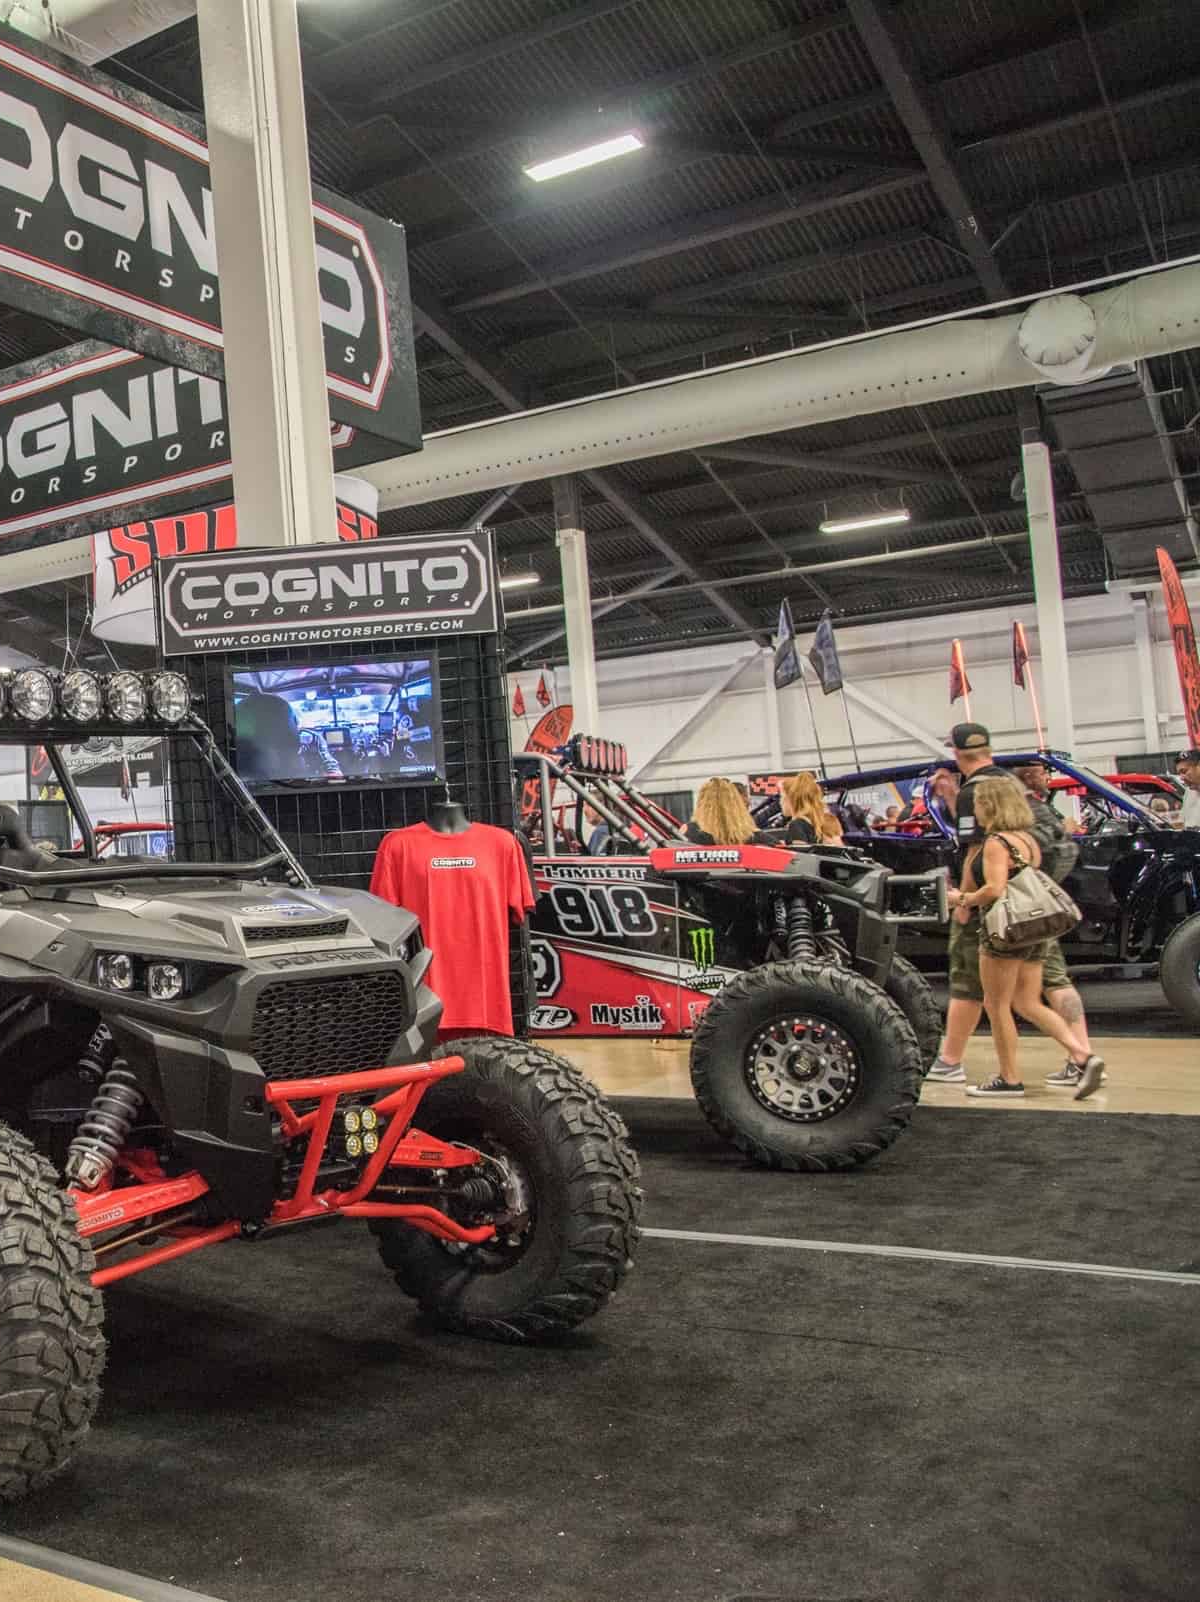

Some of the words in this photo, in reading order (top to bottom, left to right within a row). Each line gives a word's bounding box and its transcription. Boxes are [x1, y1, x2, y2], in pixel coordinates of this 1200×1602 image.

[181, 556, 469, 610] COGNITO
[196, 592, 459, 621] MOTORSPORTS
[194, 619, 464, 649] WWW.COGNITOMOTORSPORTS.COM
[432, 859, 474, 867] COGNITO
[544, 866, 646, 880] LAMBERT
[550, 886, 657, 936] 918
[533, 1008, 569, 1025] TP
[591, 1004, 661, 1025] Mystik
